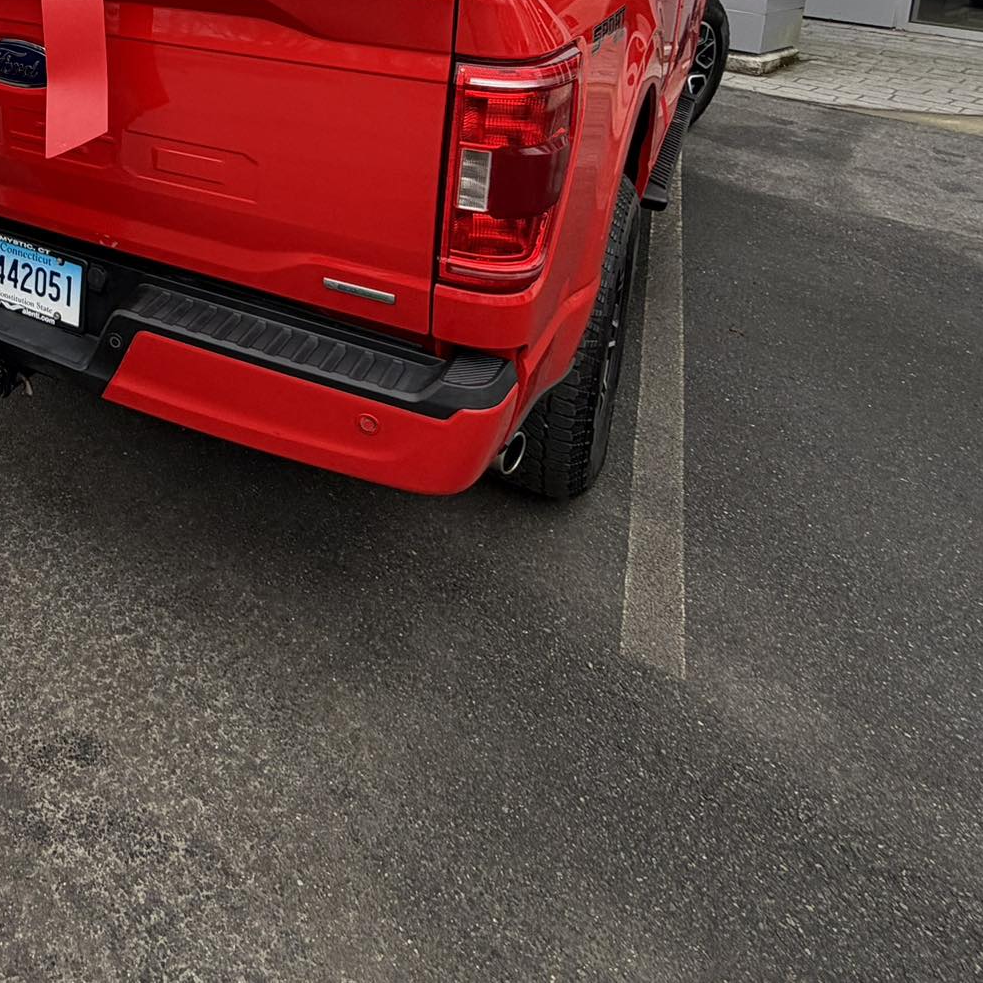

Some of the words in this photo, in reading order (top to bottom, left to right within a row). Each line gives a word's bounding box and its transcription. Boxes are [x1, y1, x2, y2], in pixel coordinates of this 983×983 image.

[0, 241, 52, 266] Connecticut
[37, 247, 51, 255] CT
[36, 302, 53, 315] State
